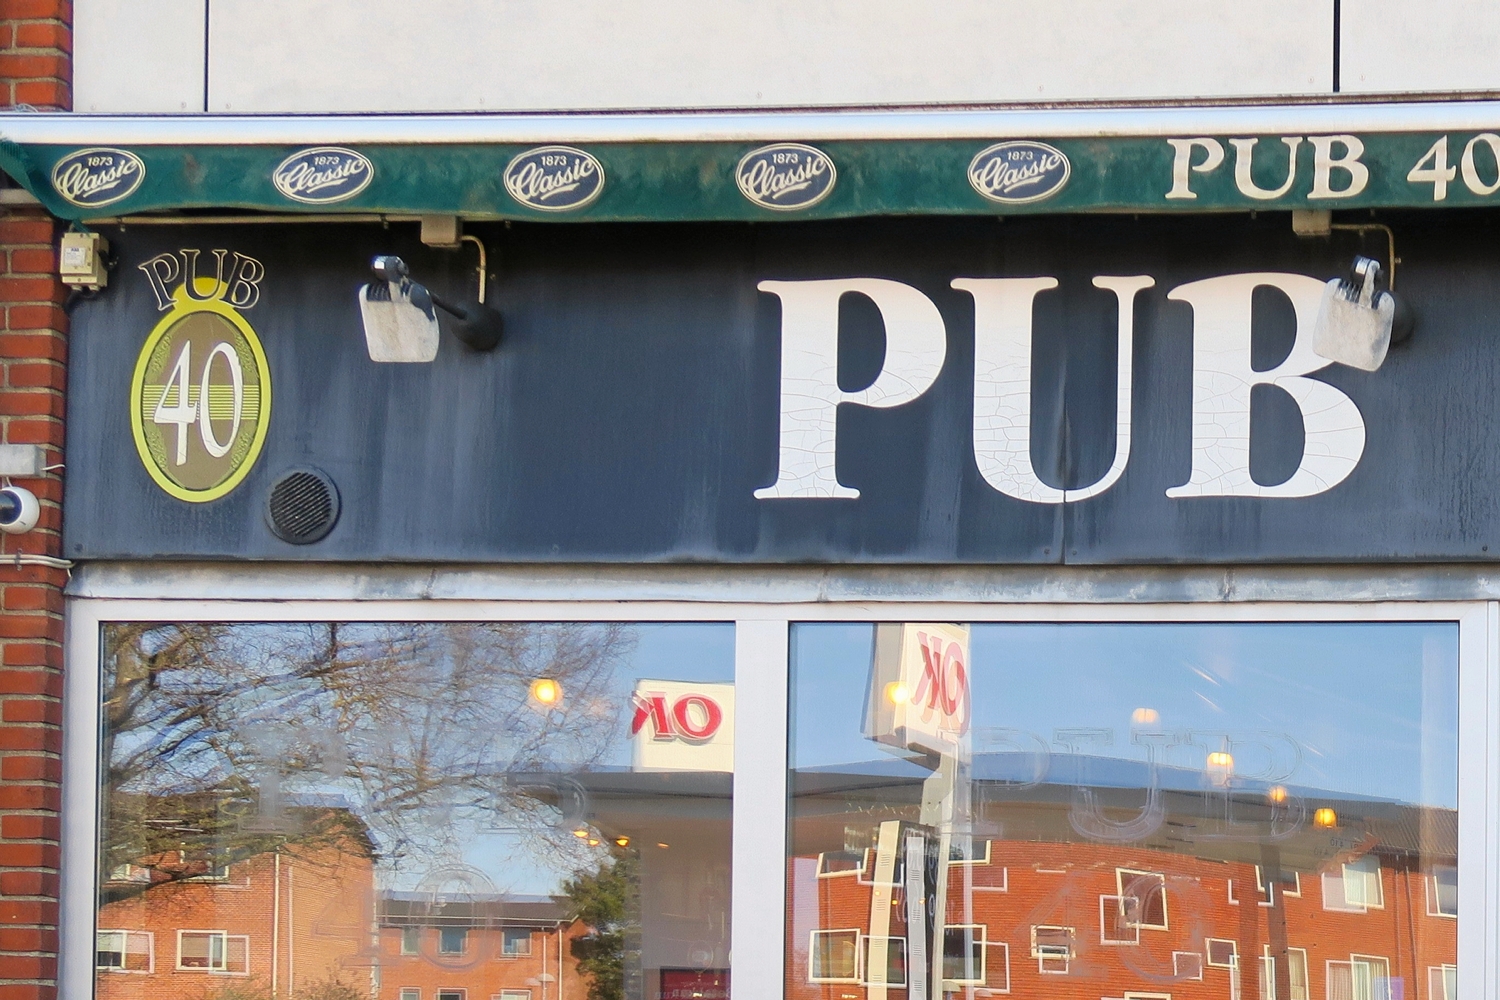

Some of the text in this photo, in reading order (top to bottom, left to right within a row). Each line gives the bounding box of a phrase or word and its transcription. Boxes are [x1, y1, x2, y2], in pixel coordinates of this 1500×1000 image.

[87, 157, 113, 166] 1873
[314, 156, 339, 165] 1873
[541, 155, 567, 166] 1873
[772, 153, 798, 164] 1873
[973, 153, 1061, 193] Classic
[1007, 151, 1033, 160] 1873
[1165, 135, 1370, 200] PUB
[55, 160, 138, 200] Classic
[275, 159, 365, 195] Classic
[511, 158, 595, 200] Classic
[741, 156, 827, 200] Classic
[138, 248, 265, 312] PUB
[153, 340, 245, 466] 40
[753, 271, 1367, 504] PUB
